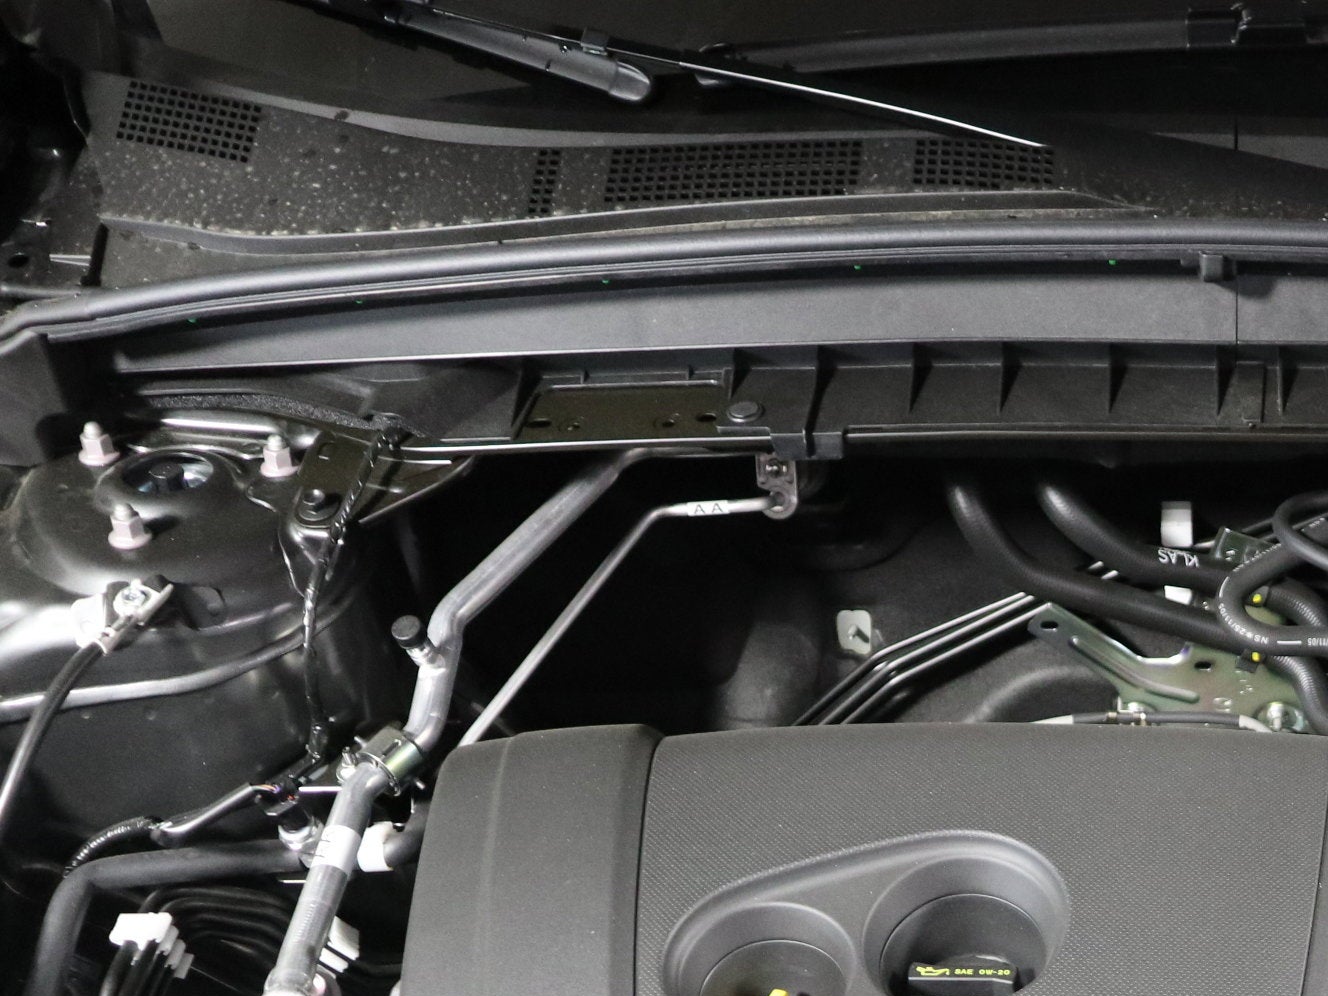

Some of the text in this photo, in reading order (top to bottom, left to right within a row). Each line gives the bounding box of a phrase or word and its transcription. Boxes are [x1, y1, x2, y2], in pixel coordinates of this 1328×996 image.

[1157, 547, 1200, 569] KLAS
[954, 968, 1011, 977] SAE 0W-20
